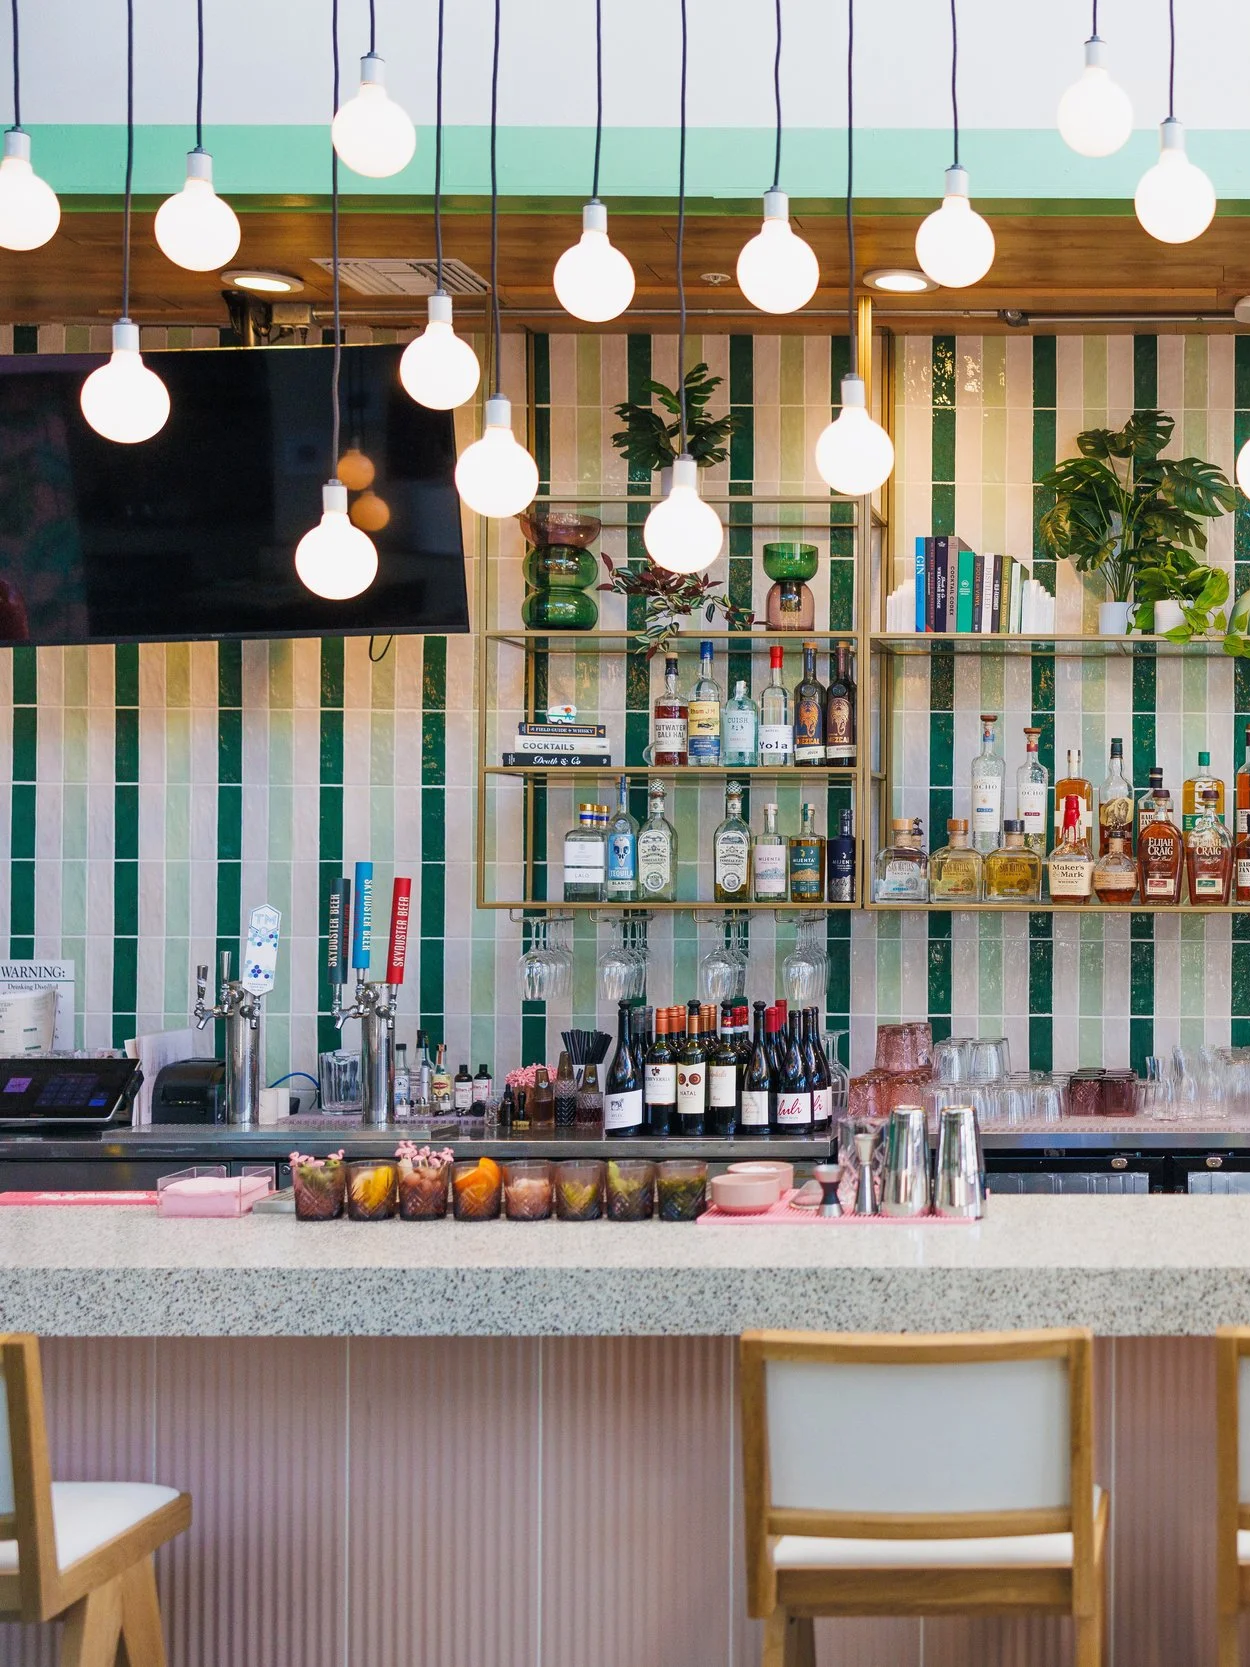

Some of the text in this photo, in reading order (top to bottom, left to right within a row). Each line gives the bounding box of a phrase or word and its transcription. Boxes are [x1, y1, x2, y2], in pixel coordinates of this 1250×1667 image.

[916, 555, 924, 575] GIN
[522, 742, 575, 751] COCKTAILS
[759, 741, 788, 749] Yola
[533, 755, 558, 765] Death
[571, 756, 582, 765] Co
[1148, 837, 1173, 847] ELIJAH
[1148, 846, 1173, 856] CRAIG
[1196, 846, 1221, 856] CRAIG
[610, 869, 634, 877] TEQUILA
[362, 879, 373, 927] SKYDUSTER
[328, 893, 340, 967] SKYDUSTER BEER
[393, 896, 409, 967] SKYDUSTER BEER
[1, 966, 65, 978] WARNING:
[7, 983, 33, 991] Drinking
[777, 1098, 802, 1116] luli
